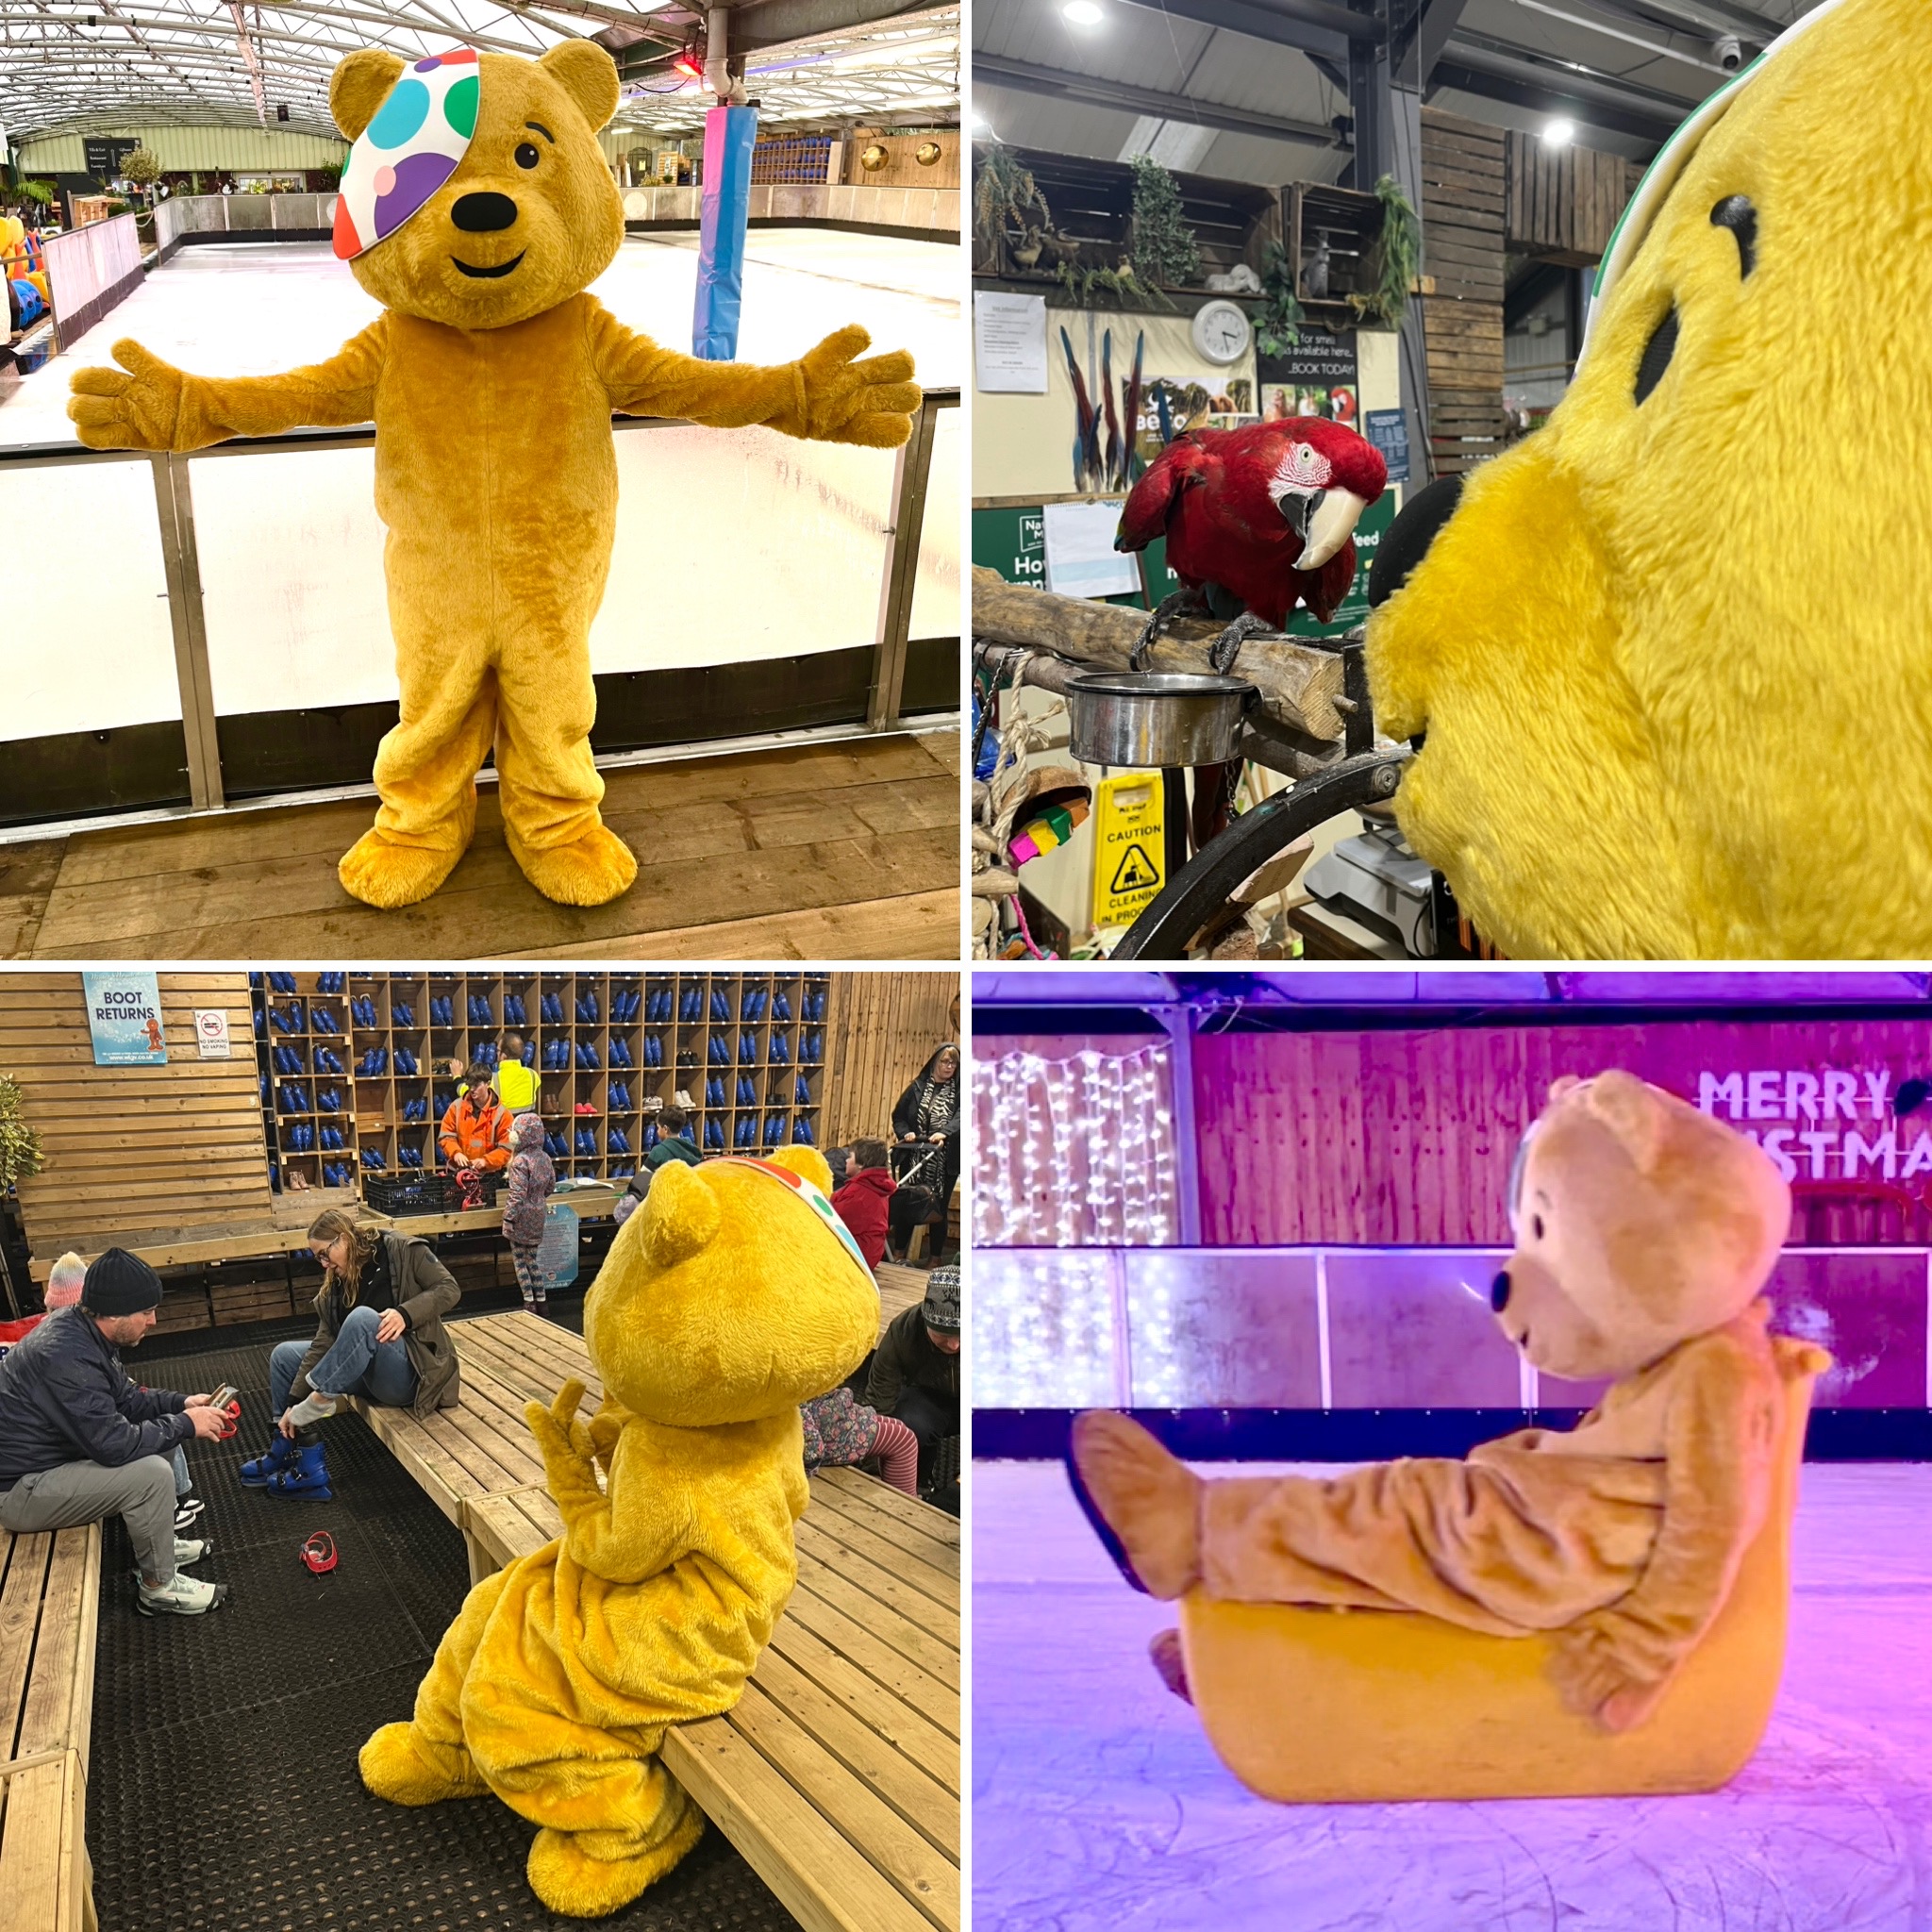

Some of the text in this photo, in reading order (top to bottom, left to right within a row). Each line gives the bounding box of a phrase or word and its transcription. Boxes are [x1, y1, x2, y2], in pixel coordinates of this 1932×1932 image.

[1300, 333, 1314, 344] for
[1292, 345, 1329, 357] available
[1108, 824, 1161, 842] CAUTION
[104, 991, 142, 1004] BOOT
[96, 1008, 155, 1020] RETURNS
[1699, 1070, 1890, 1120] MERRY
